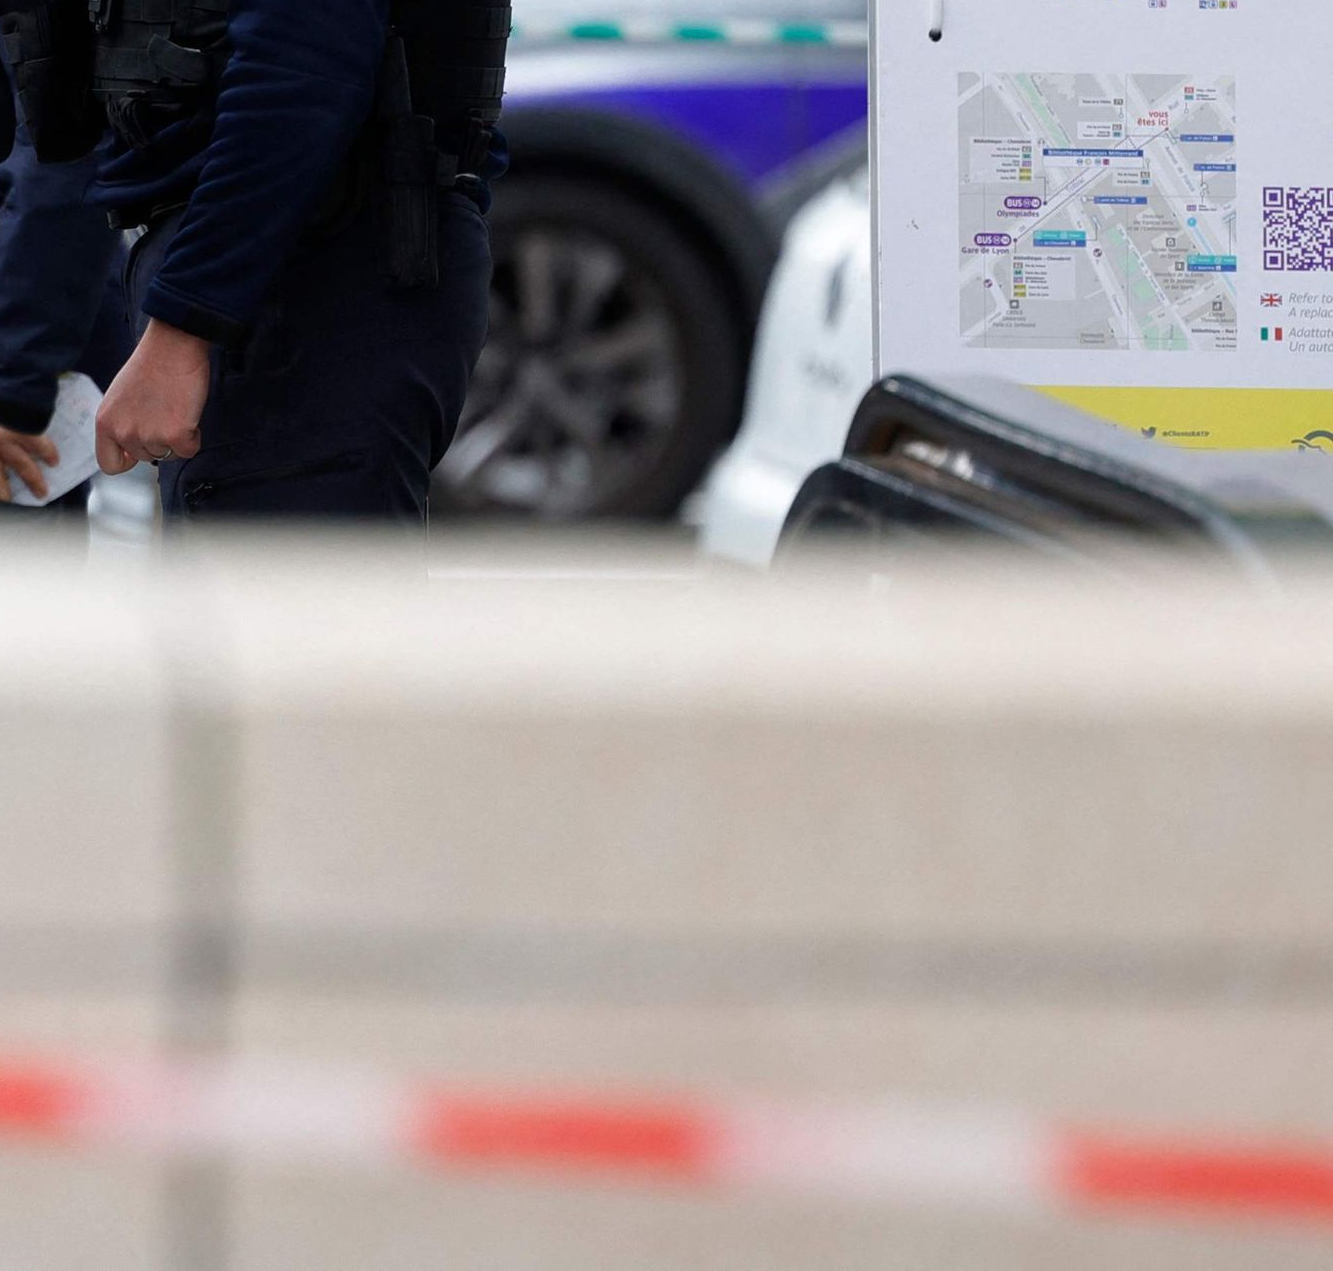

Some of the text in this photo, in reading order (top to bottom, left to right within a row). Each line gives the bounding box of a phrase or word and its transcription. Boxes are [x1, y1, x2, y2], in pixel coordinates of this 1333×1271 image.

[1137, 118, 1168, 126] êtes ici
[1007, 199, 1022, 207] BUS
[997, 210, 1039, 218] Olympiades
[992, 247, 1009, 255] Lyon
[1289, 293, 1318, 303] Refer
[1288, 308, 1296, 317] A
[1289, 342, 1305, 352] Un
